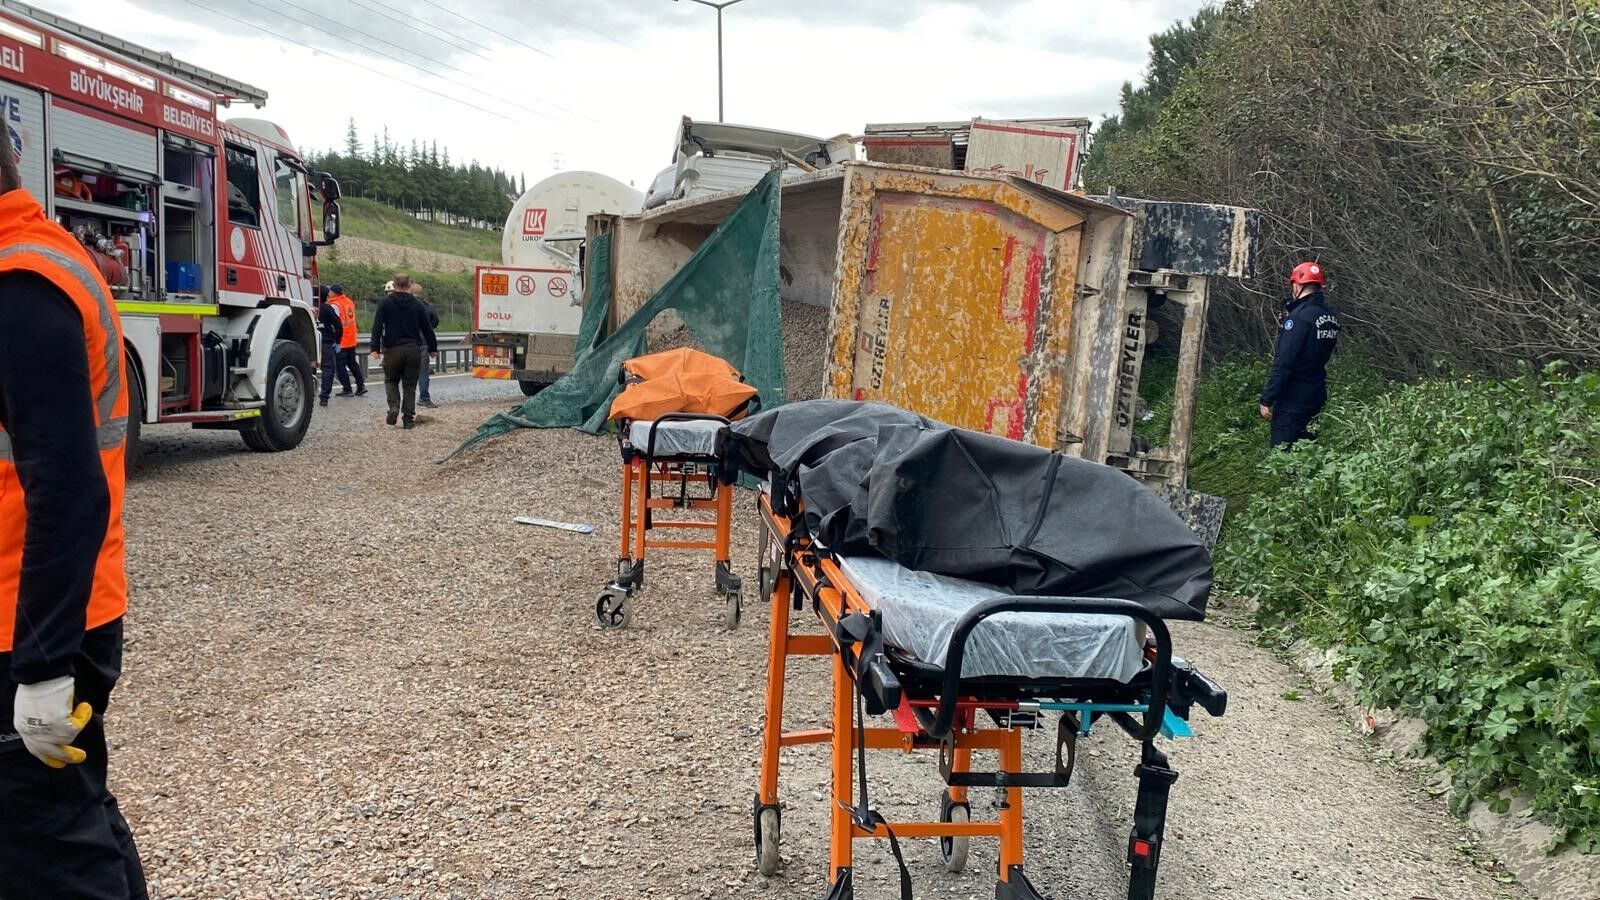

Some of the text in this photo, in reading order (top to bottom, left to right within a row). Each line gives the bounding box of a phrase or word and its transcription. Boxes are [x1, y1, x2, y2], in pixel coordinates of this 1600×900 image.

[0, 46, 214, 137] ELİ BÜYÜKŞEHİR BELEDİYESİ
[490, 276, 500, 284] 23
[484, 285, 506, 294] 1965
[1316, 328, 1338, 339] İTFAİY
